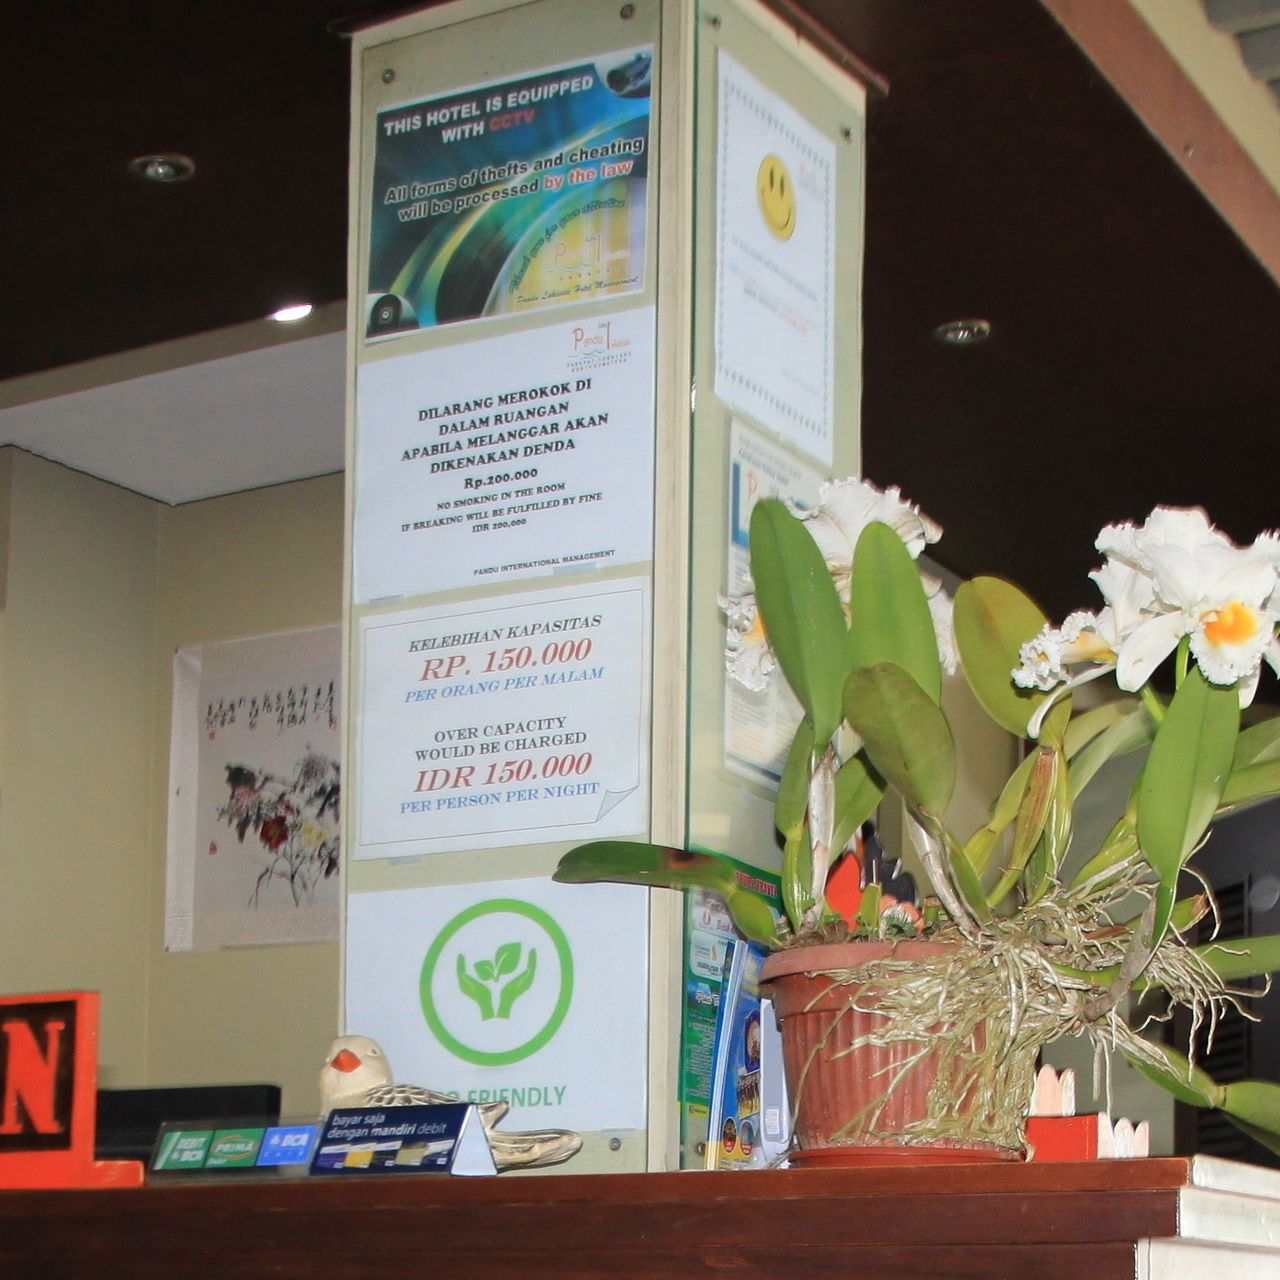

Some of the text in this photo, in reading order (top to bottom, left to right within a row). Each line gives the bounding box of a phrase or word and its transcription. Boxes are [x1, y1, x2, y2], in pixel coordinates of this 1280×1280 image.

[383, 75, 594, 136] THIS HOTEL IS EQUIPPED
[441, 109, 536, 144] WITH CCTV
[384, 137, 645, 205] All forms of thefts and cheating
[399, 159, 634, 222] will be processed by the law
[418, 378, 592, 422] DILARANG MEROKOK DI
[438, 401, 570, 436] DALAM RUANGAN
[401, 412, 609, 461] APABILA MELANGGAR AKAN
[430, 438, 576, 474] DIKENAKAN DENDA
[436, 482, 567, 511] NO SMOKING IN THE ROOM
[463, 468, 539, 490] Rp.200.000
[401, 492, 604, 532] IF BREAKING WILL BE FULFILLED BY FINE
[472, 523, 490, 533] IDR
[473, 549, 616, 576] PANDU INTERNATIONAL MANAGEMENT
[408, 614, 603, 653] KELEBIHAN KAPASITAS
[419, 637, 593, 682] RP. 150.000
[404, 666, 606, 704] PER ORANG PER MALAM
[415, 731, 588, 762] WOULD BE CHARGED
[433, 716, 568, 744] OVER CAPACITY
[413, 751, 593, 793] IDR 150.000
[400, 781, 601, 815] PER PERSON PER NIGHT
[468, 1085, 566, 1107] FRIENDLY
[327, 1122, 448, 1140] dengan mandiri debit
[332, 1112, 386, 1127] bayar saja
[215, 1141, 254, 1153] PRIMA
[280, 1133, 310, 1147] BCA
